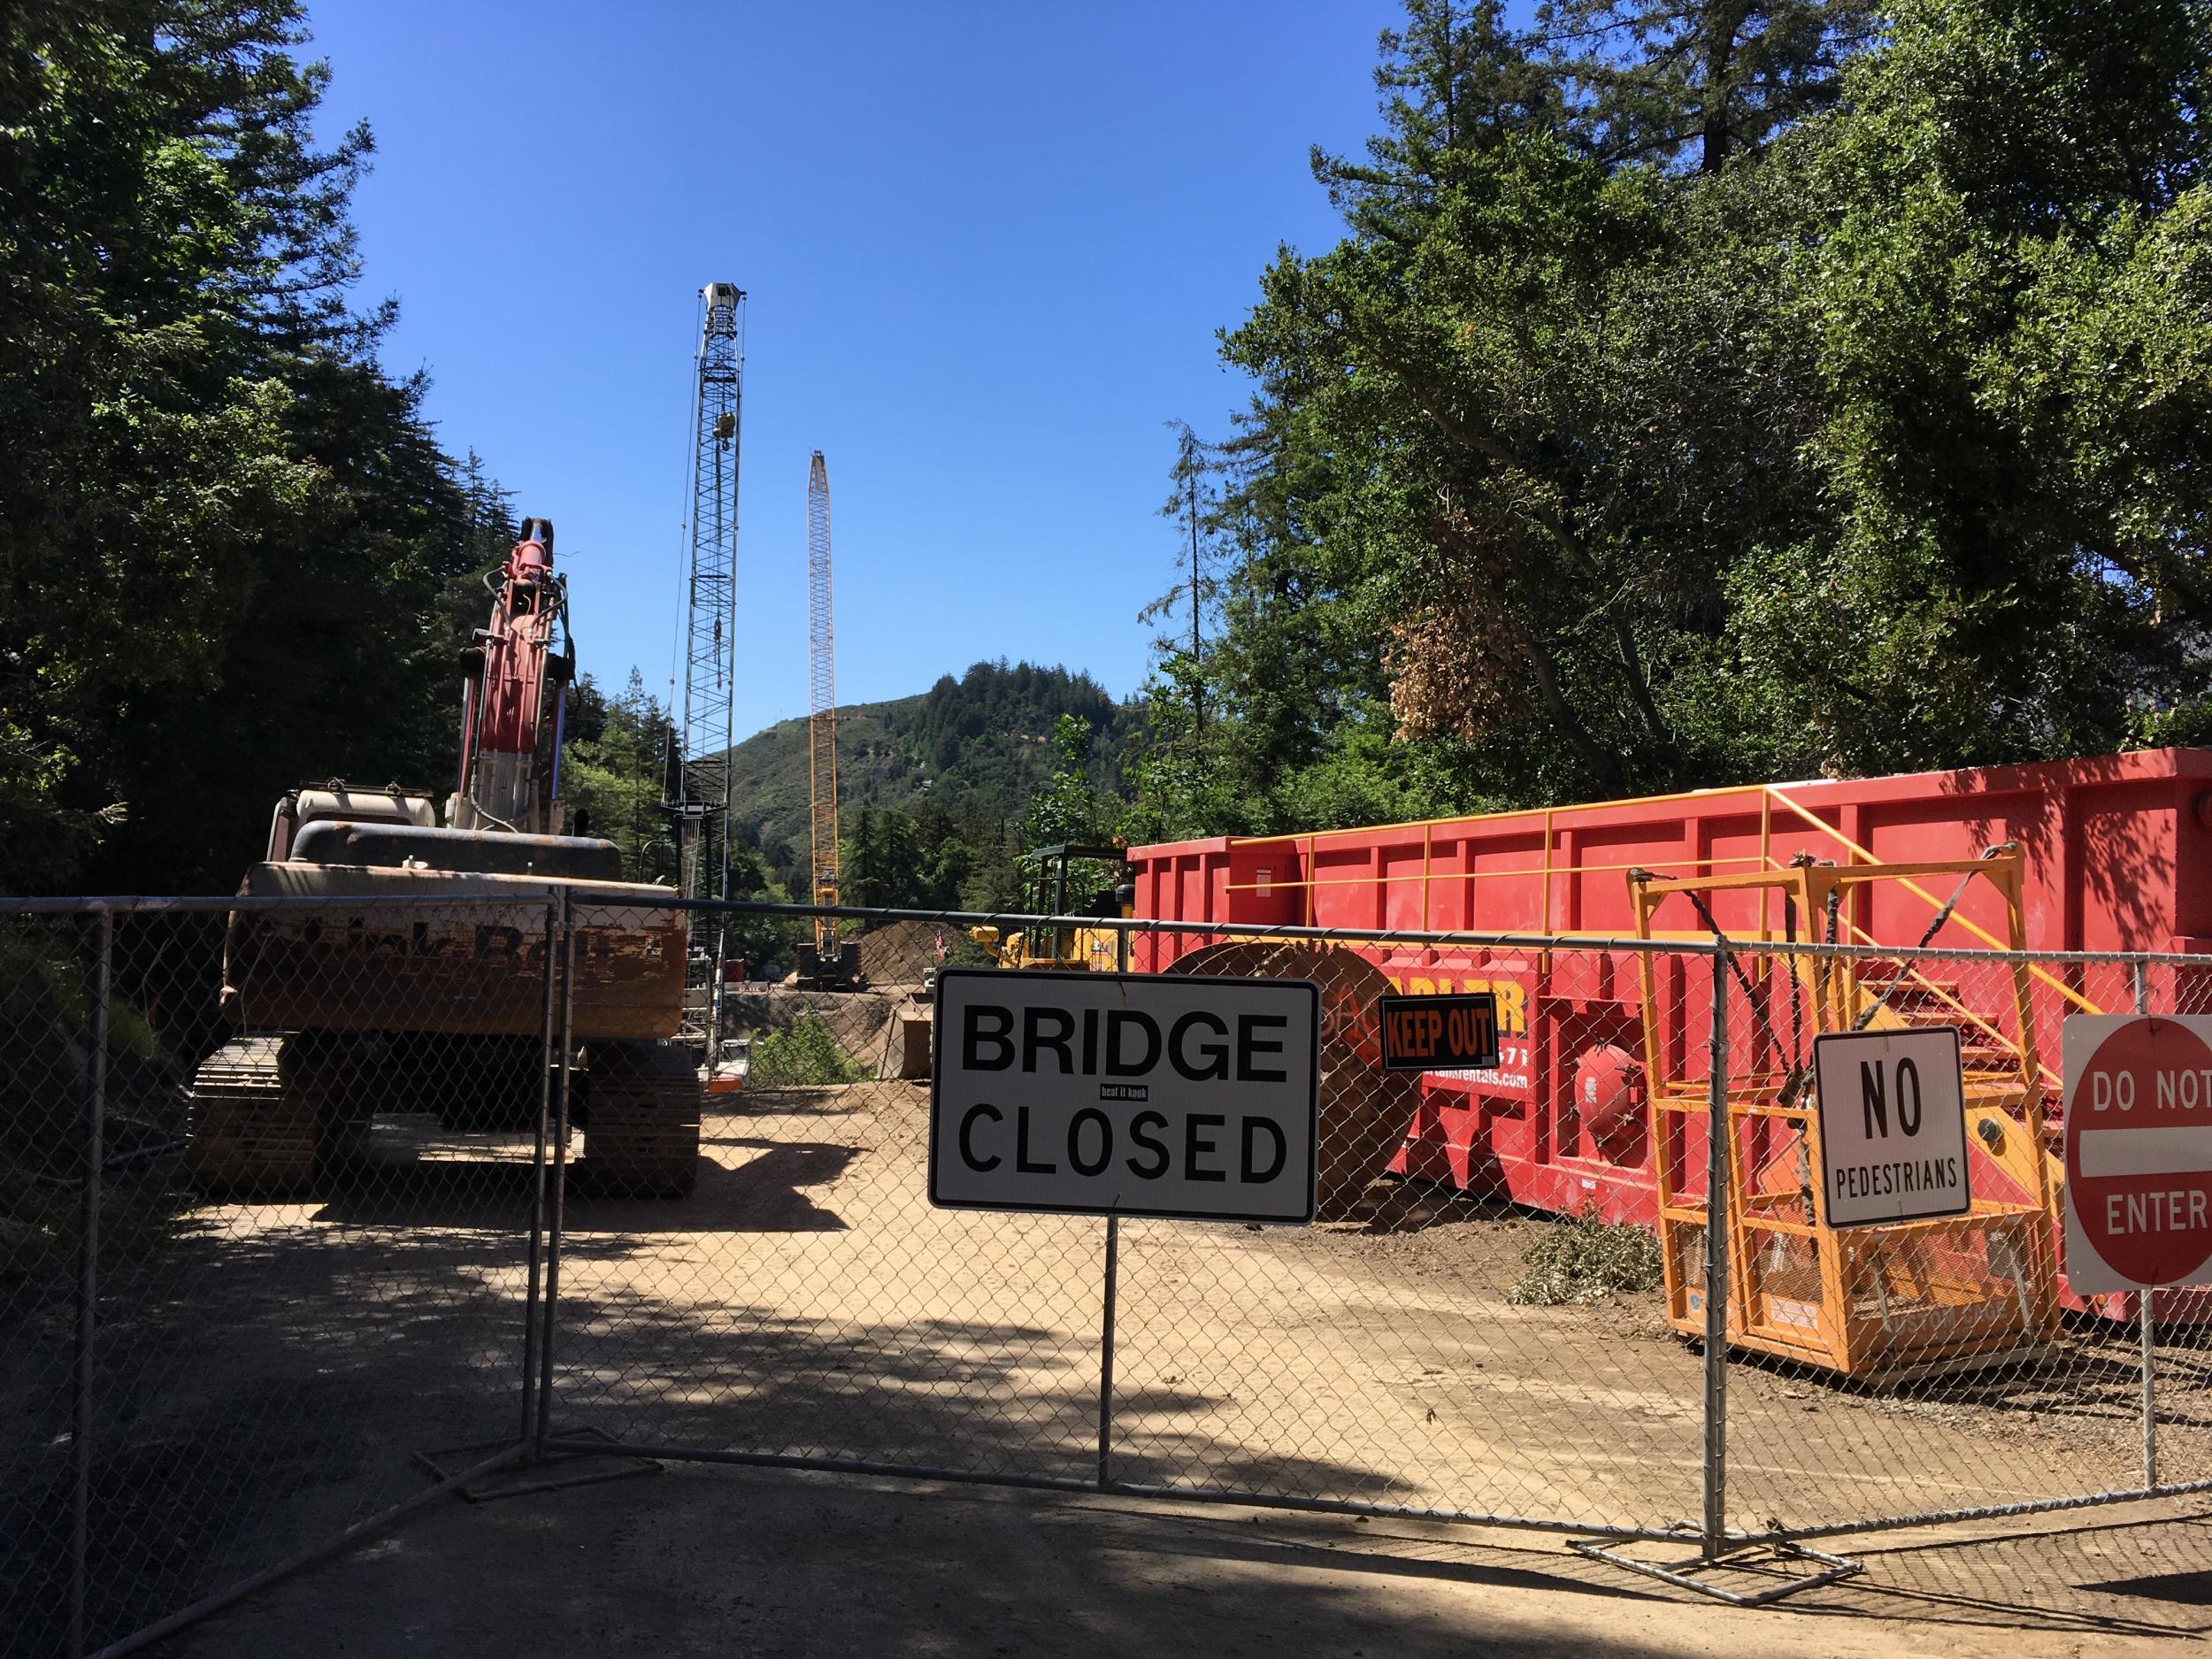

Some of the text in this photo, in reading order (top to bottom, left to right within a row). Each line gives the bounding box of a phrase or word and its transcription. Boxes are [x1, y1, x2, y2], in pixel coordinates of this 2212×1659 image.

[962, 1004, 1288, 1082] BRIDGE
[1386, 1010, 1442, 1058] KEEP
[1448, 1007, 1490, 1057] OUT
[1120, 1087, 1126, 1097] it
[1860, 1056, 1922, 1140] NO
[2093, 1069, 2212, 1111] DO NOT
[958, 1102, 1288, 1184] CLOSED
[1836, 1157, 1958, 1200] PEDESTRIANS
[2108, 1189, 2208, 1236] ENTER
